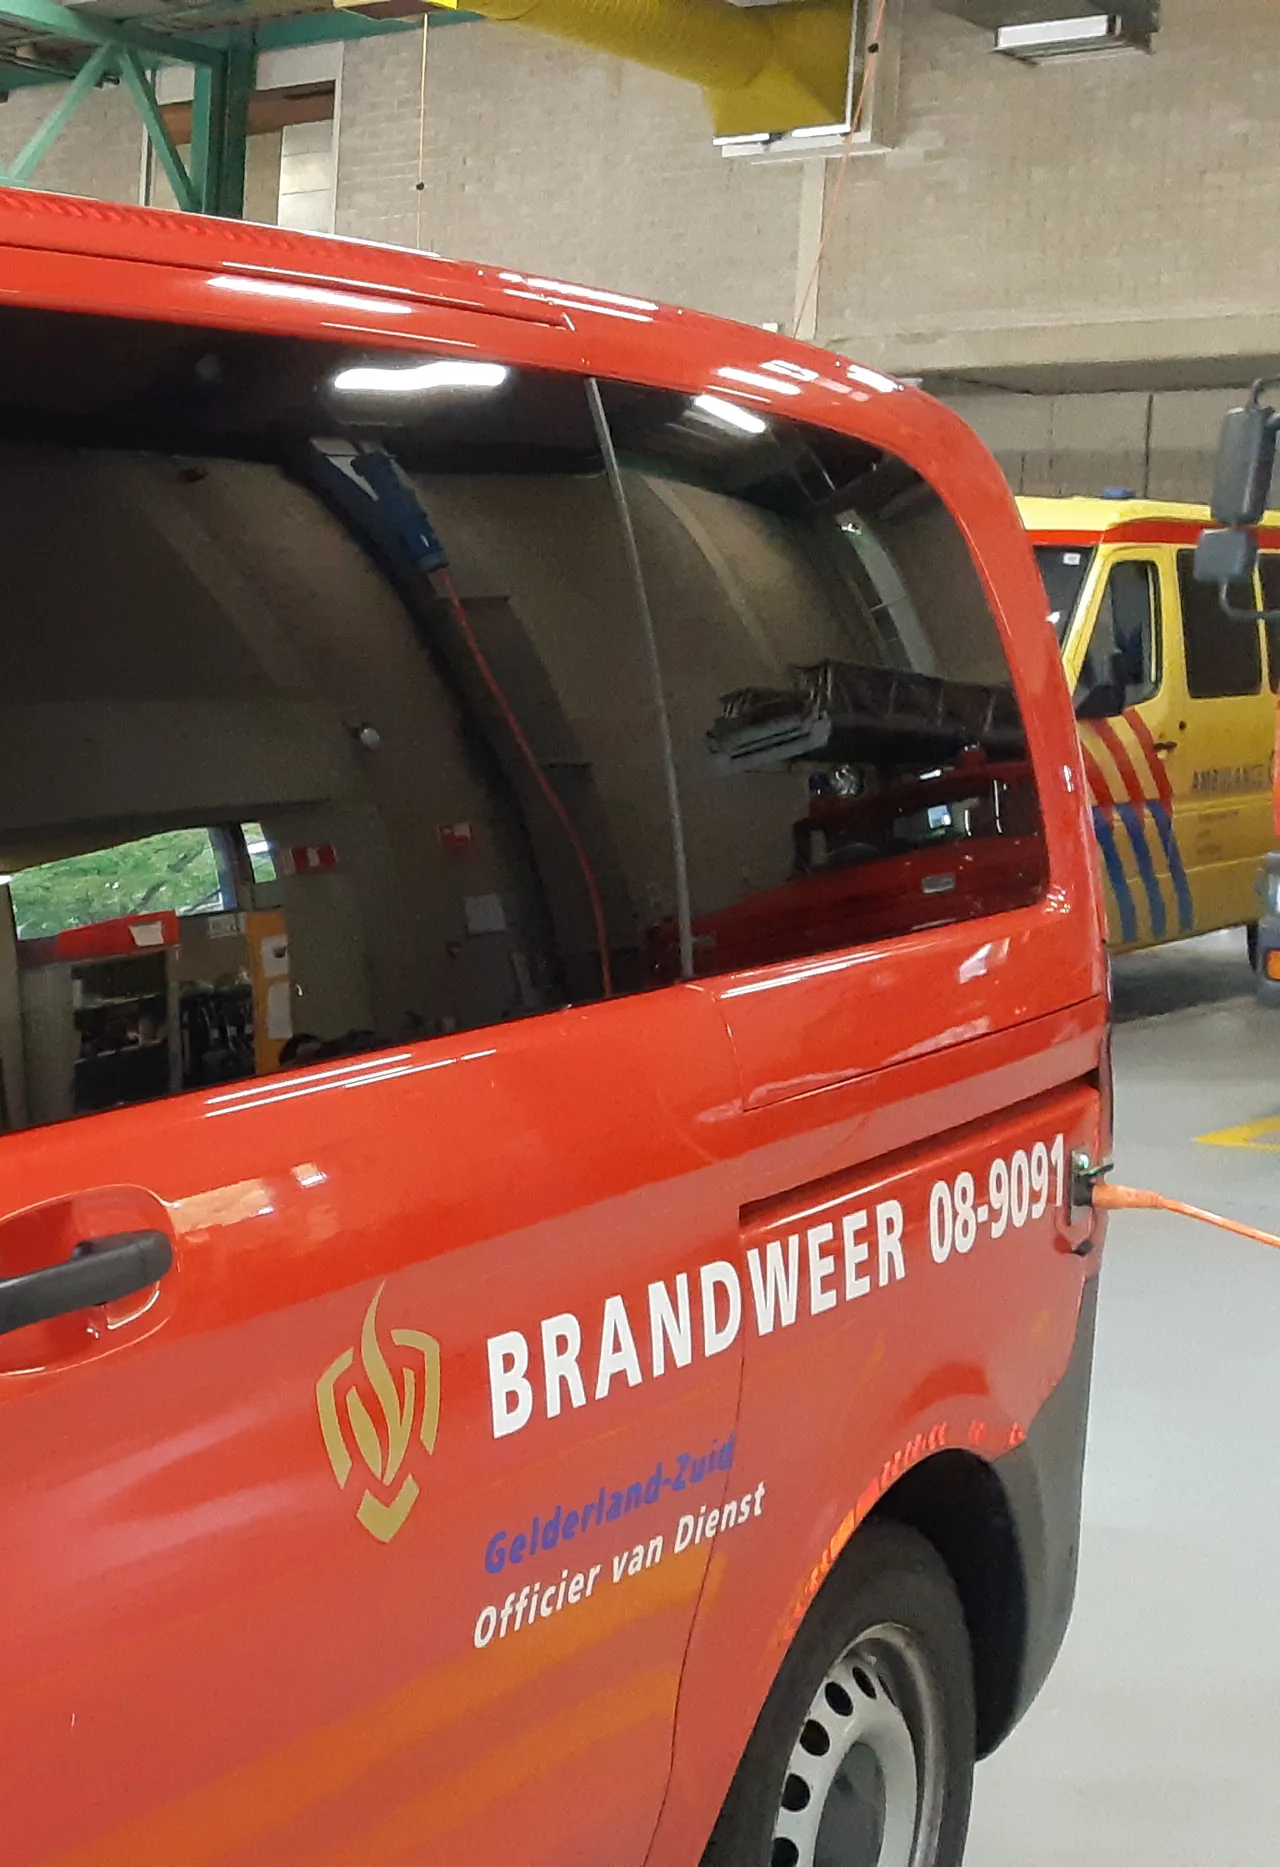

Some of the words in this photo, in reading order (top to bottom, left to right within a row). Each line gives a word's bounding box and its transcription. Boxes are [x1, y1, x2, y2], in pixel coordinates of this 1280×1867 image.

[487, 1199, 905, 1438] BRANDWEER
[929, 1133, 1065, 1263] 08-9091
[473, 1563, 602, 1648] Officier
[612, 1534, 664, 1584] van
[673, 1481, 767, 1553] Dienst
[484, 1429, 737, 1574] Gelderland-Zuid
